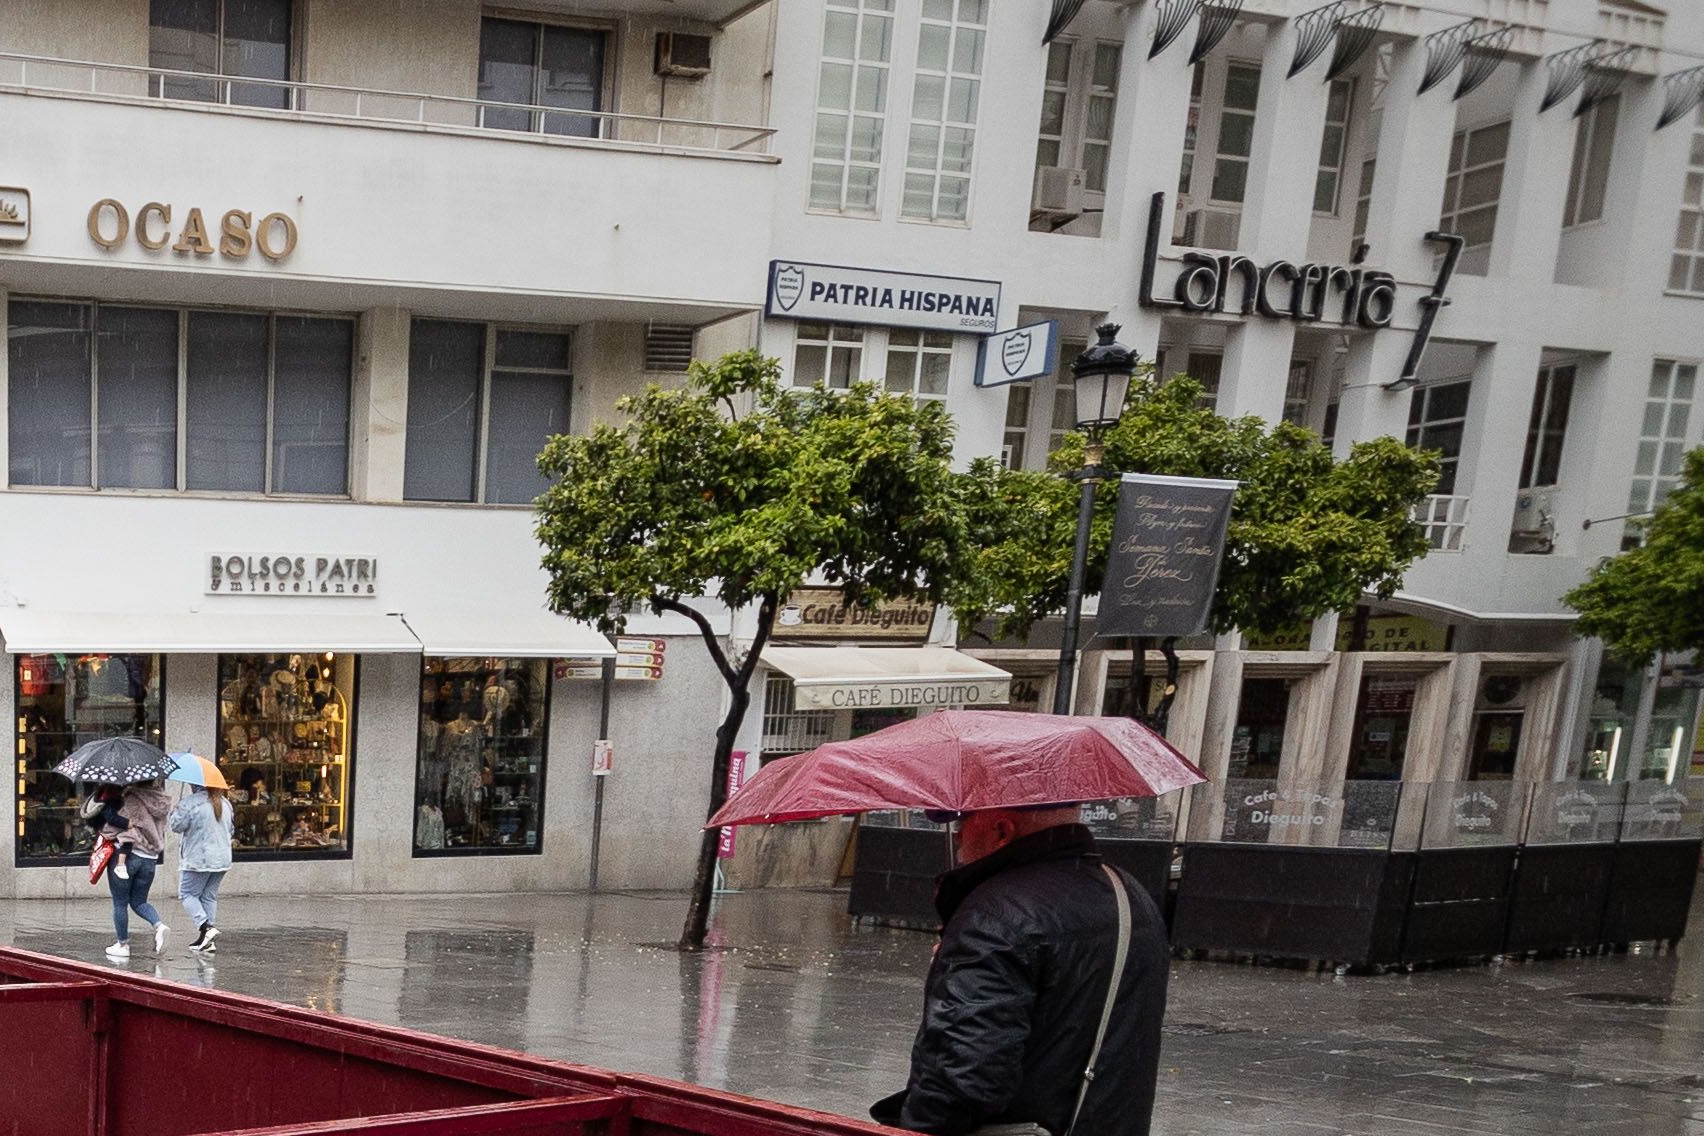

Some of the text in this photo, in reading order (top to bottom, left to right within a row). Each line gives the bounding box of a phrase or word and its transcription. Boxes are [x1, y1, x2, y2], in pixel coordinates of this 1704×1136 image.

[87, 198, 298, 261] OCASO
[810, 281, 995, 318] PATRIA HISPANA
[960, 317, 995, 329] SEGUROS
[211, 555, 377, 581] BOLSOS PATRI
[852, 604, 928, 629] Dieguito
[832, 684, 980, 707] CAFÉ DIEGUITO
